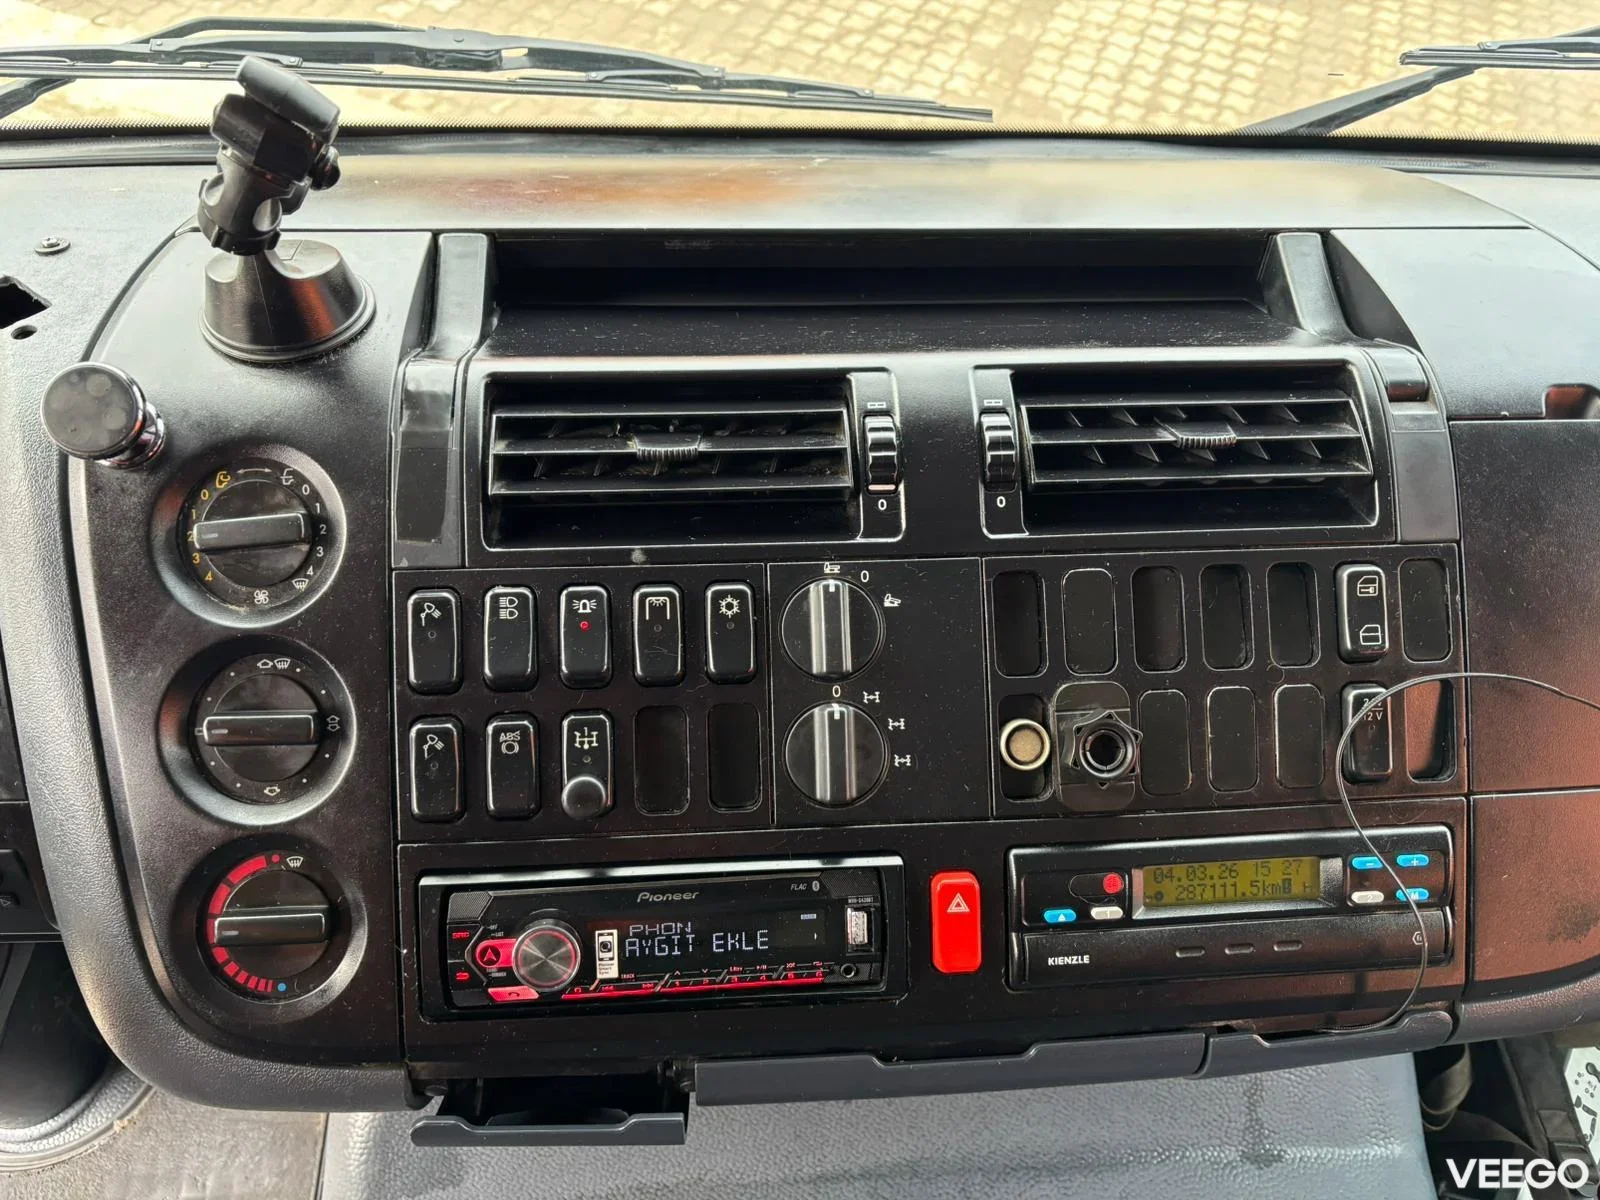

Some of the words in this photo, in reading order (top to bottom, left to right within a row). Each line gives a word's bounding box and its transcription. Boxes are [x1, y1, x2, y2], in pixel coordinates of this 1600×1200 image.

[201, 489, 209, 500] 0
[302, 484, 310, 495] 0
[878, 499, 887, 511] 0
[997, 496, 1006, 508] 0
[315, 503, 320, 513] 1
[191, 509, 196, 519] 1
[320, 525, 327, 535] 2
[317, 547, 324, 557] 3
[193, 553, 200, 564] 3
[205, 570, 214, 581] 4
[306, 565, 314, 576] 4
[861, 570, 870, 582] 0
[832, 685, 841, 697] 0
[1375, 711, 1383, 721] V
[500, 731, 520, 742] ABS
[1152, 863, 1239, 884] 04.03.26
[790, 883, 807, 891] FLAC
[637, 891, 699, 903] Pioneer
[629, 921, 692, 937] PHON
[625, 934, 696, 958] AYGIT
[712, 929, 769, 952] EKLE
[1047, 954, 1090, 966] KIENZLE
